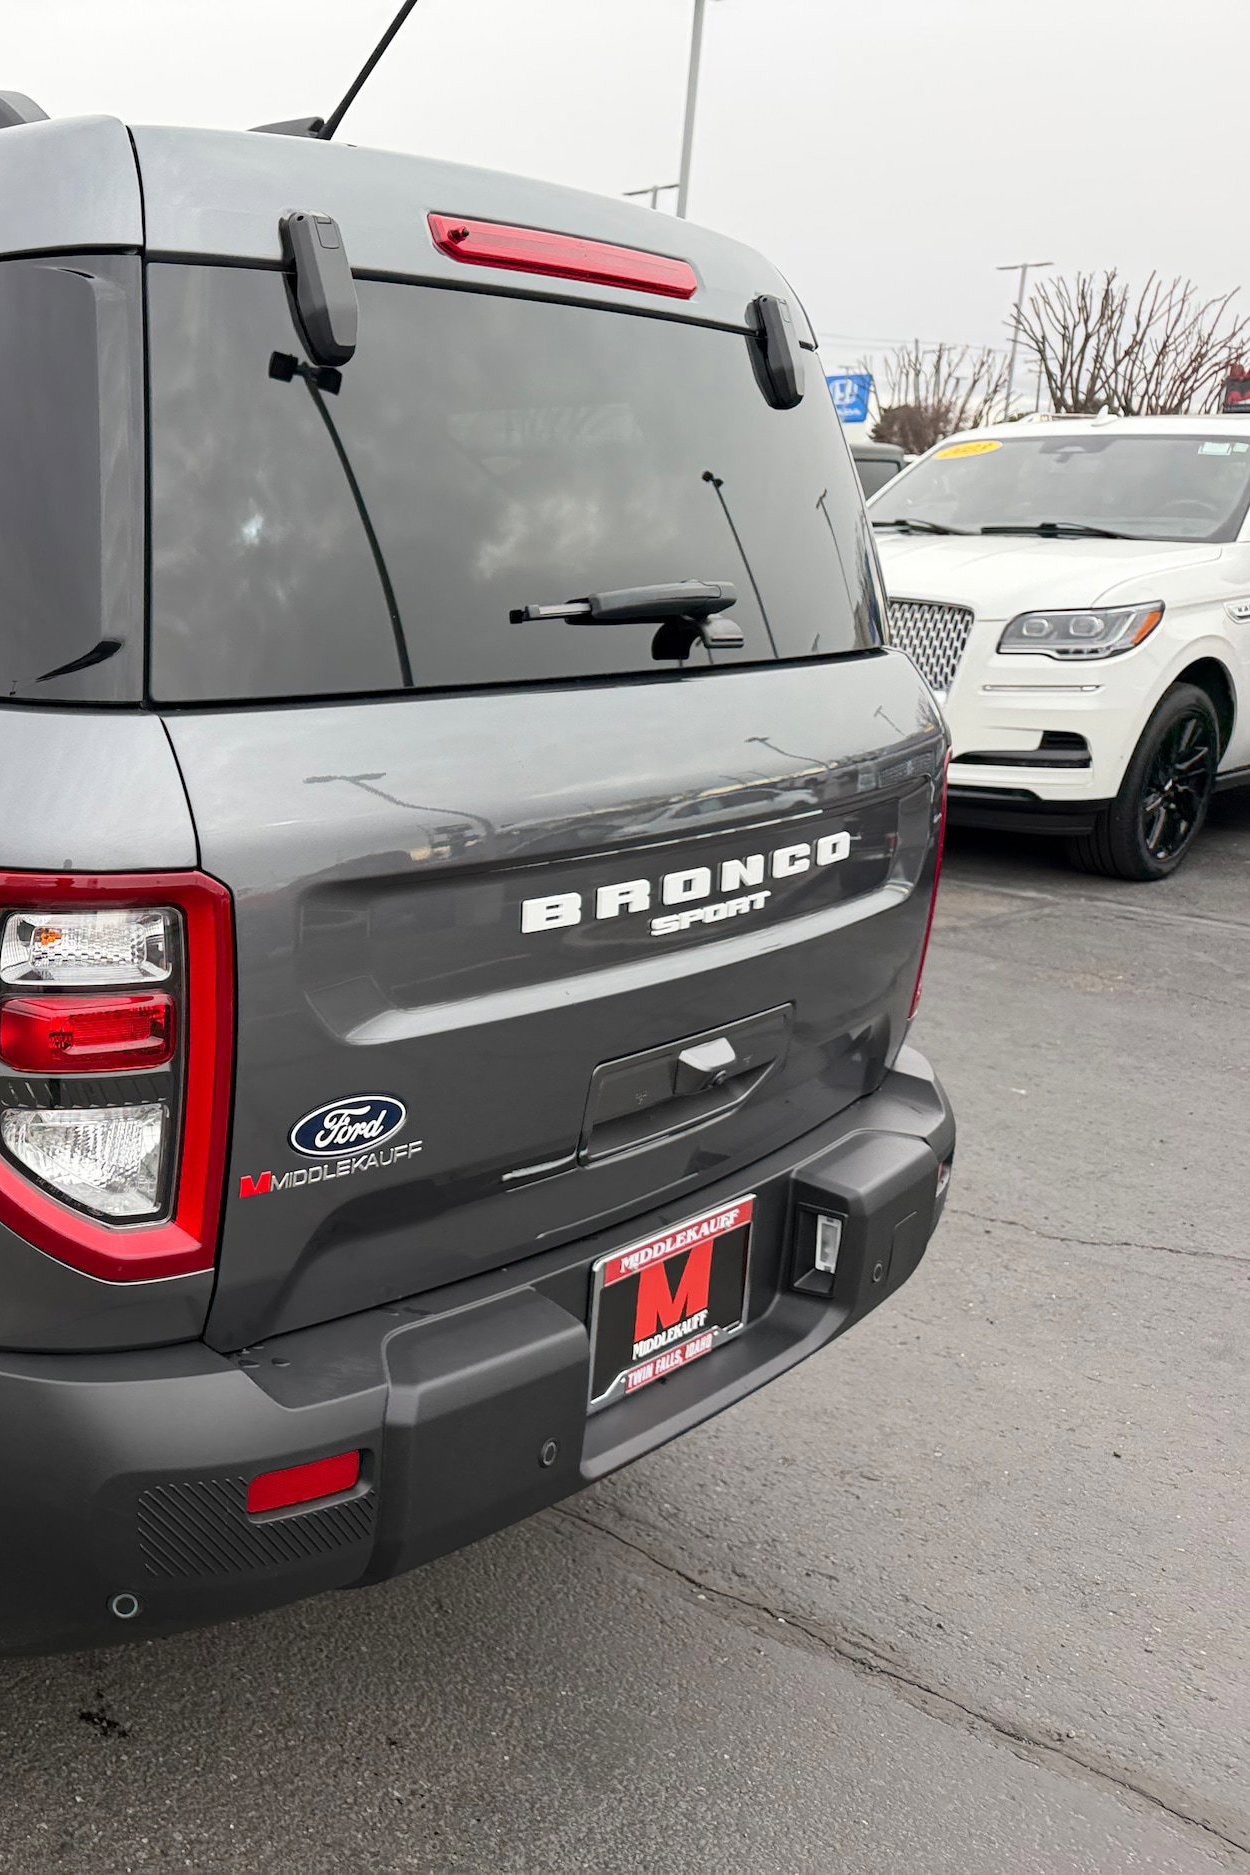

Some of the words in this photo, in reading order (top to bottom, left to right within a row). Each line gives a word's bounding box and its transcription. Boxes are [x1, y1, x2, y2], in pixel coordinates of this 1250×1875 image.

[521, 831, 850, 934] BRONCO
[651, 890, 771, 936] SPORT
[314, 1105, 387, 1148] Ford
[270, 1140, 423, 1192] MIDDLEKAUFF
[619, 1208, 740, 1274] MIDDLEKAUFF
[633, 1238, 714, 1343] M
[627, 1368, 653, 1388] TWIN
[684, 1332, 713, 1360] IDAHO
[632, 1309, 709, 1361] MIDDLEKAUFF
